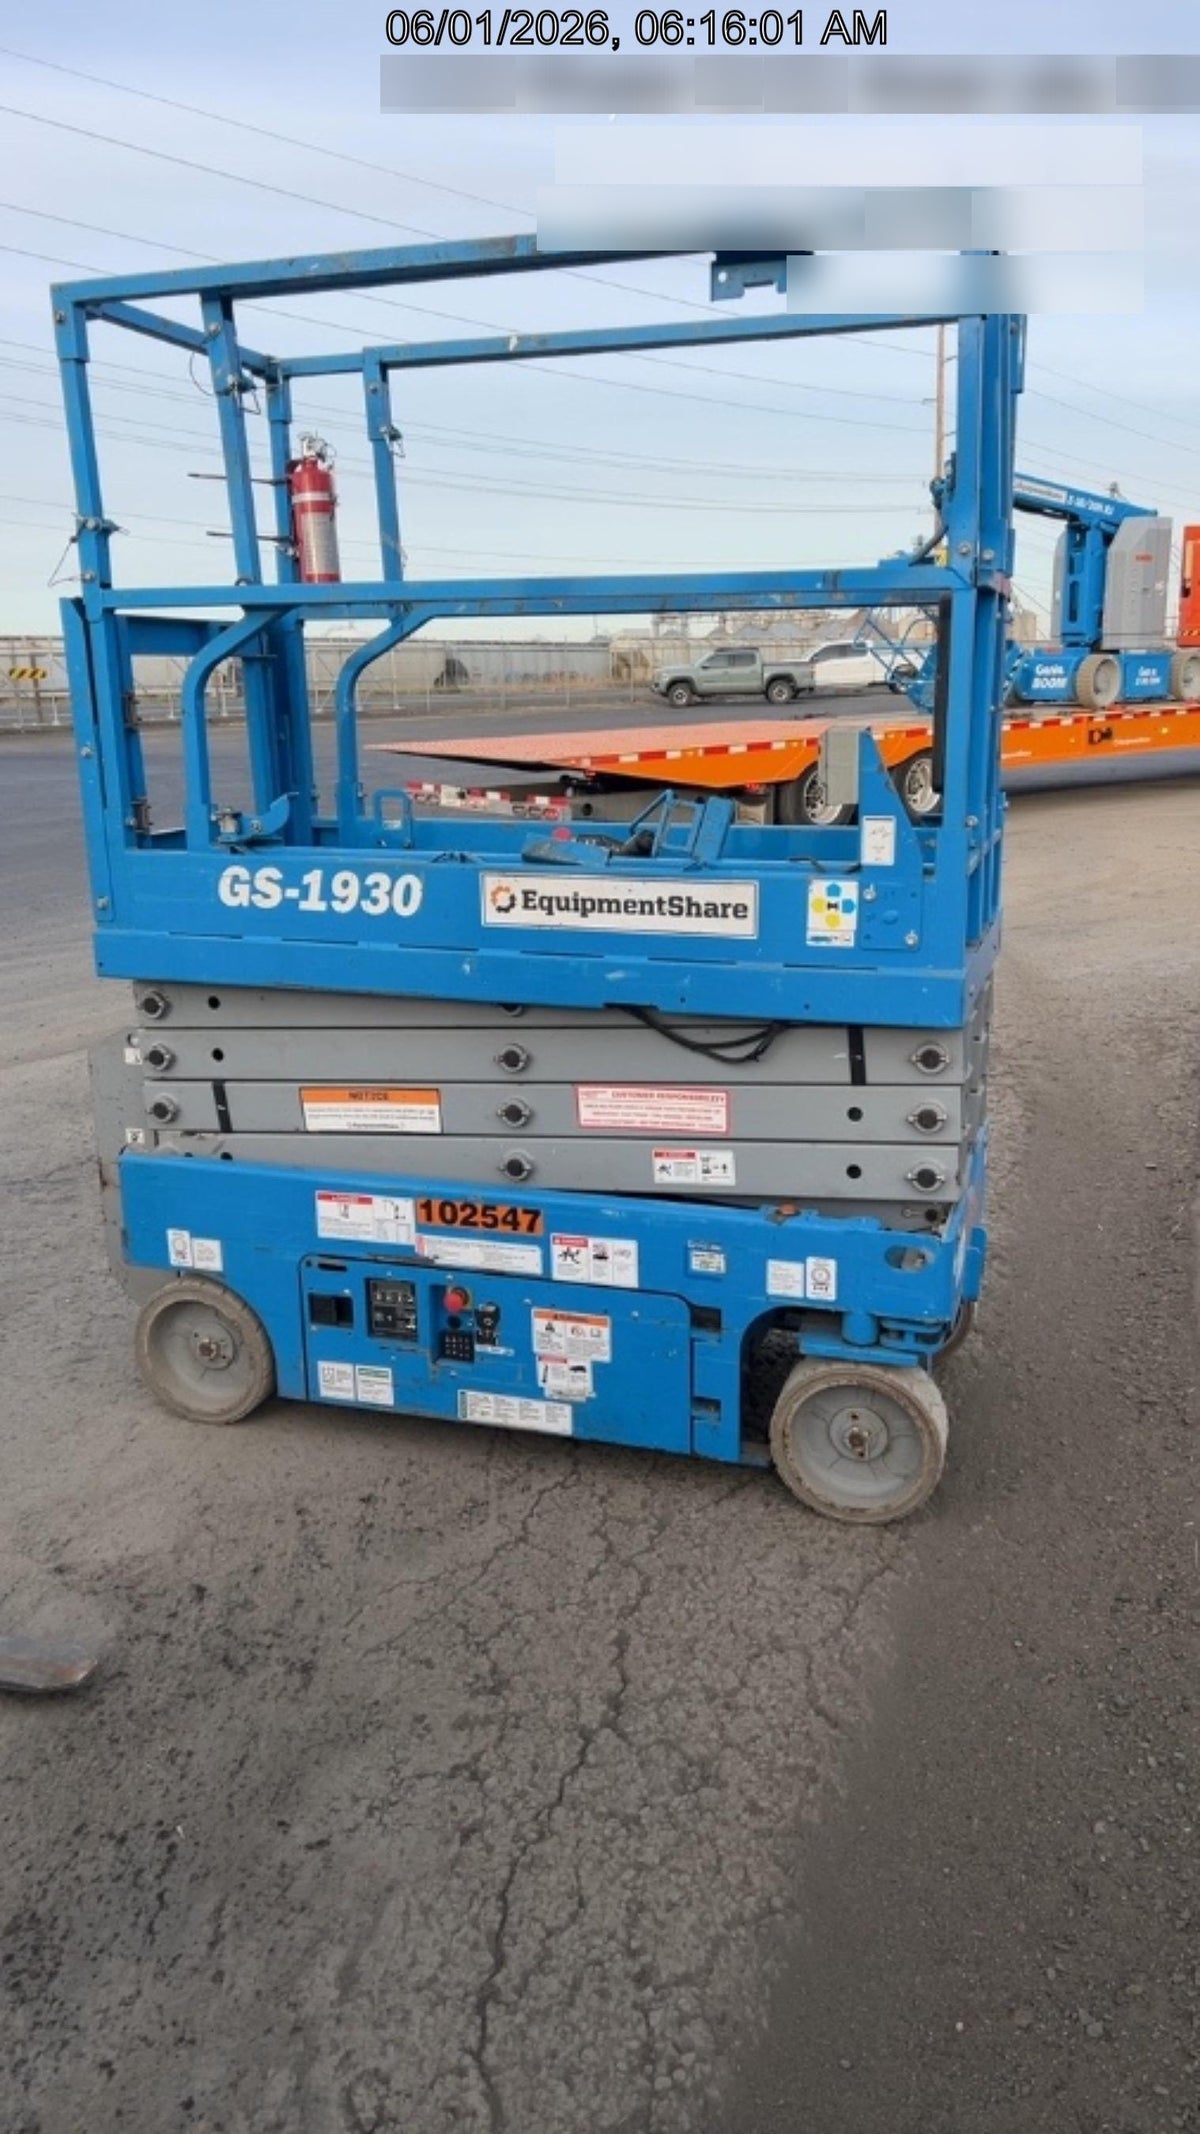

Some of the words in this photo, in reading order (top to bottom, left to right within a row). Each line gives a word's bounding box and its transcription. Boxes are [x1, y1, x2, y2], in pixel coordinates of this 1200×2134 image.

[218, 865, 423, 917] GS-1930
[521, 889, 749, 919] EquipmentShare
[419, 1198, 541, 1233] 102547
